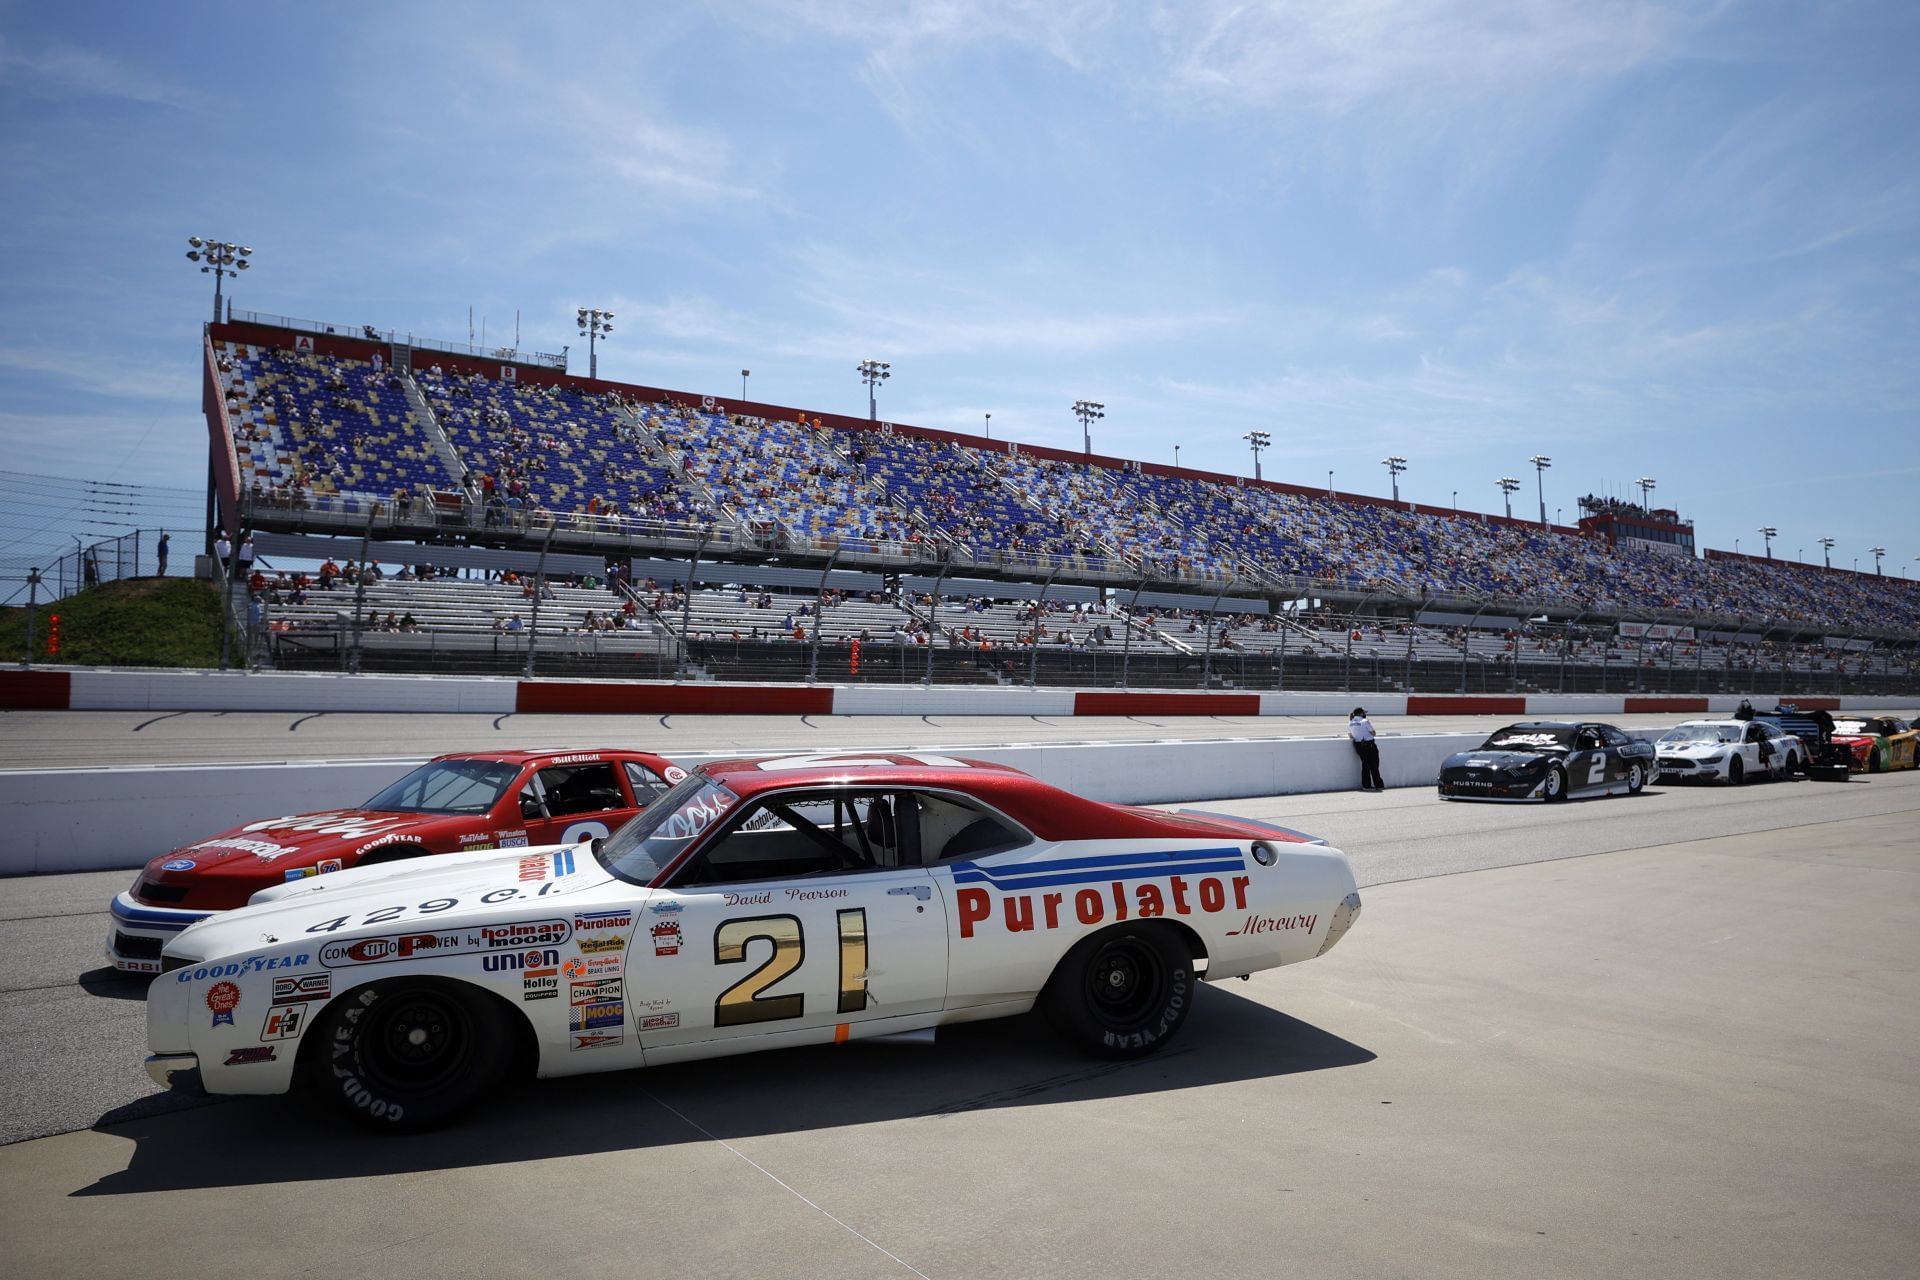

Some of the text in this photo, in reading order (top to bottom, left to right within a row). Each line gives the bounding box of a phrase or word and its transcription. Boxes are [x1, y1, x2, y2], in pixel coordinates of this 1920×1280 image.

[1587, 752, 1606, 784] 2
[1453, 780, 1493, 788] MUSTANG
[746, 811, 777, 831] Motorc
[498, 830, 527, 839] Winston
[355, 832, 422, 856] GOODYEAR
[501, 838, 527, 848] BUSCH
[723, 888, 849, 907] David Pearson
[956, 875, 1251, 939] Purolator
[304, 898, 459, 933] 429
[481, 923, 566, 939] holman
[574, 917, 632, 931] Purolator
[1225, 913, 1319, 936] Mercury
[488, 931, 565, 948] moody
[324, 935, 480, 961] COMPETITION PROVEN by
[177, 954, 310, 983] GOODYEAR
[587, 965, 620, 975] BRAKE LINING
[713, 905, 869, 1029] 21
[217, 984, 230, 993] the
[275, 983, 293, 992] BORG
[302, 979, 329, 988] WARNER
[523, 977, 558, 989] Holley
[210, 990, 236, 1002] Great
[524, 990, 558, 999] EQUIPPED
[573, 985, 620, 998] CHAMPION
[214, 1000, 233, 1010] Ones
[586, 1004, 624, 1018] MOOG
[1103, 968, 1187, 1049] GOODYEAR
[332, 989, 405, 1122] GOODYEAR
